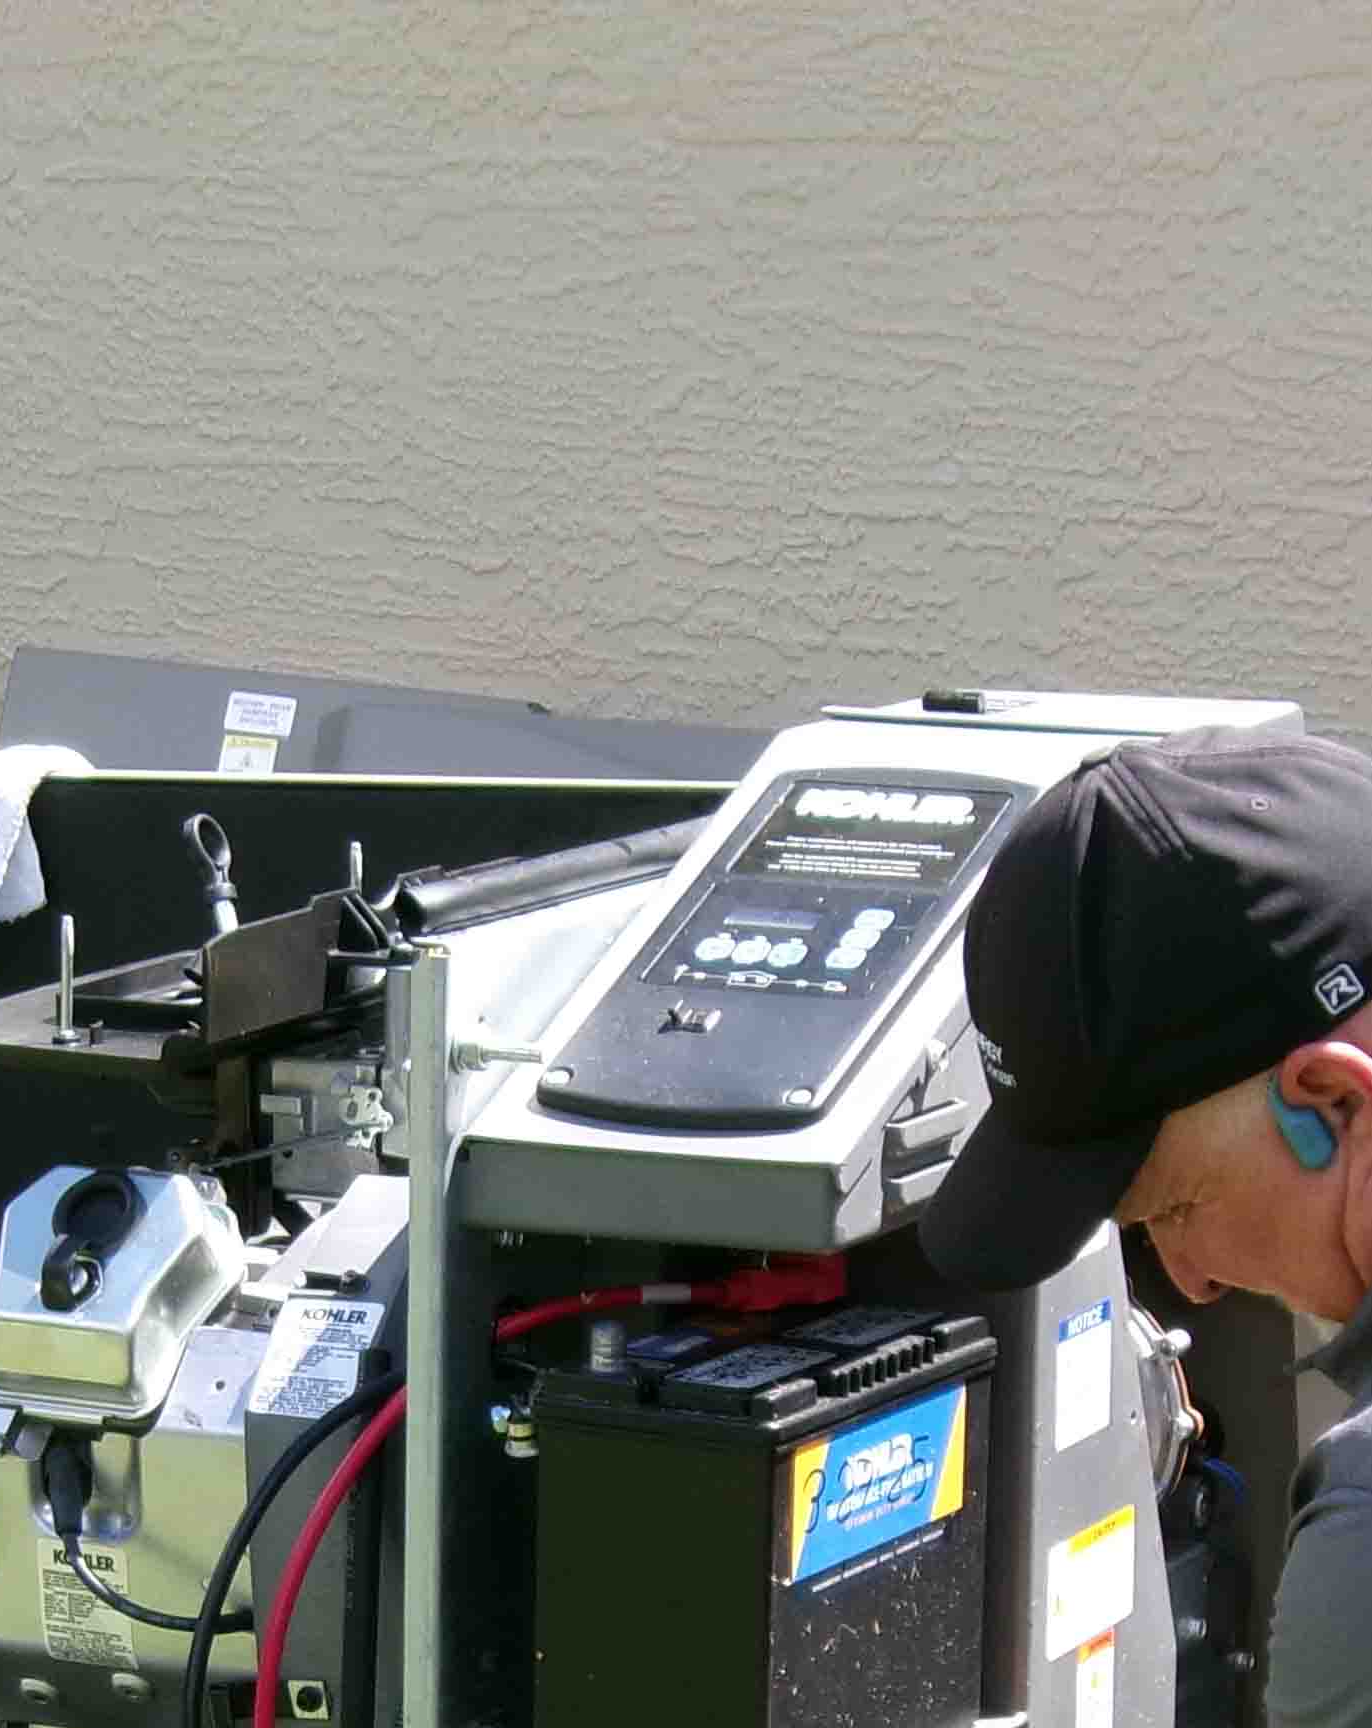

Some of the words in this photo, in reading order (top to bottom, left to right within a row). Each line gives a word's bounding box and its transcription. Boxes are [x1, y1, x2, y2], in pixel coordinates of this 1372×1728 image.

[301, 1308, 368, 1325] KOHLER
[1067, 1304, 1104, 1338] NOTICE
[52, 1548, 116, 1572] KLER
